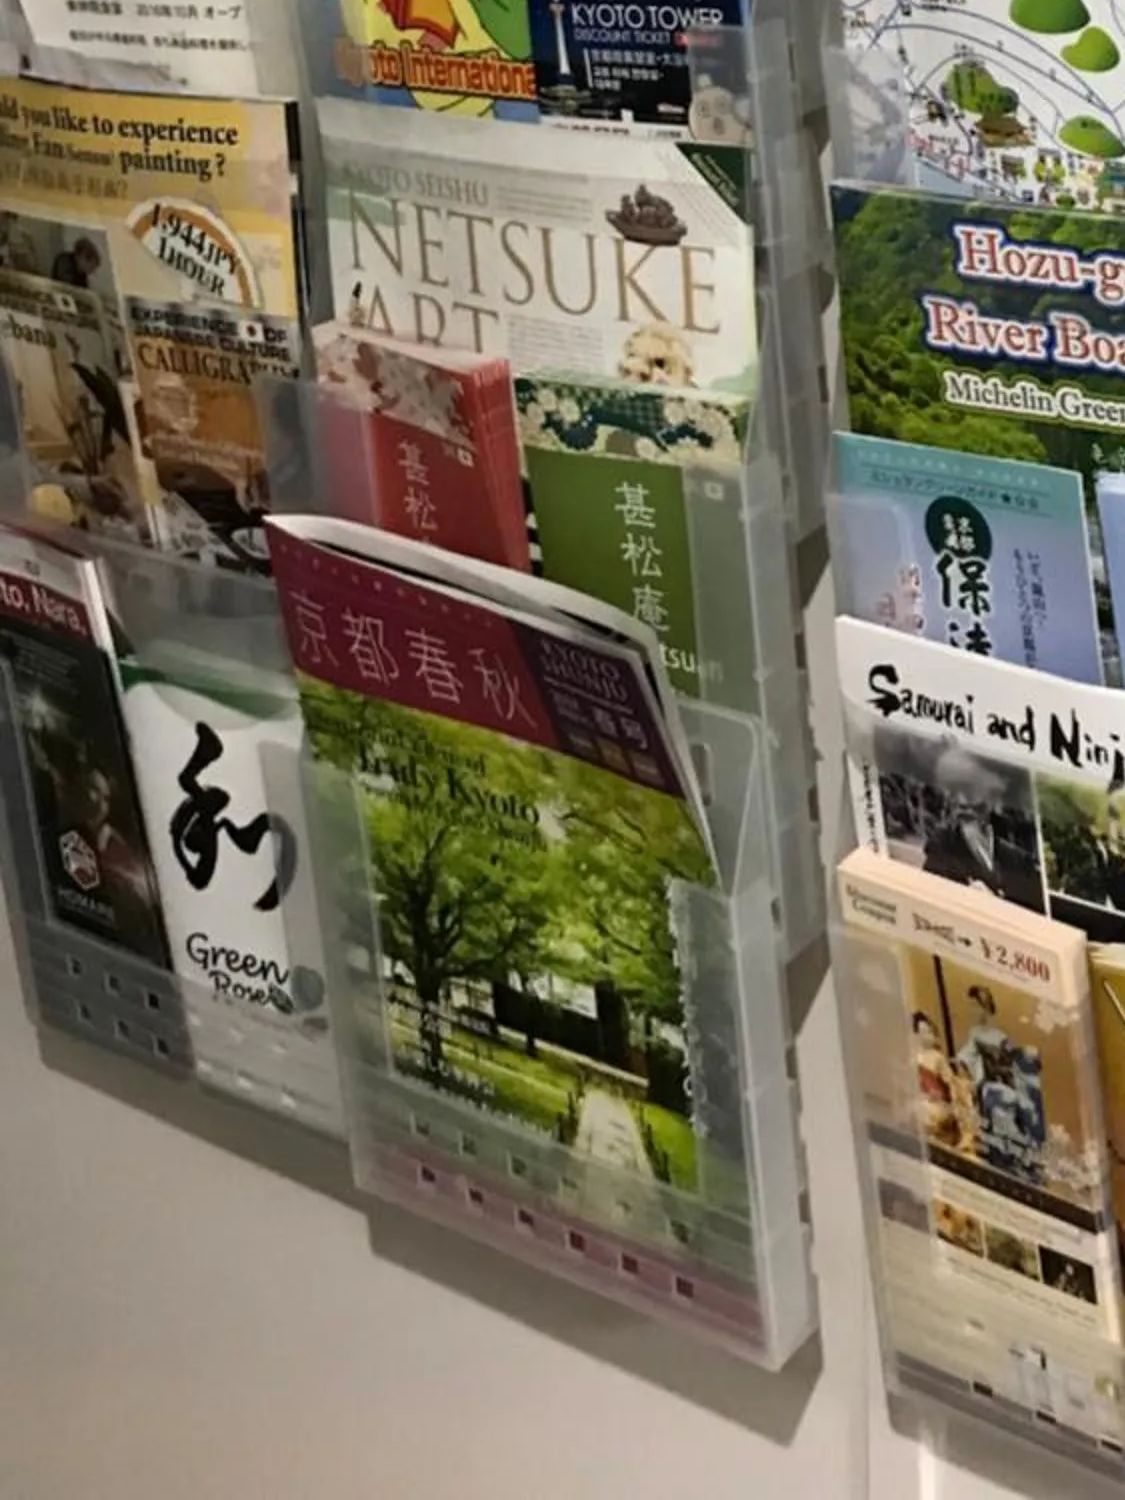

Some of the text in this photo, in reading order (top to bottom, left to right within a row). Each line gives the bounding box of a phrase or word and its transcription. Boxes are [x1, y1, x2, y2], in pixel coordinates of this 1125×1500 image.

[570, 2, 724, 31] KYOTO TOWER
[574, 28, 672, 44] DISCOUNT TICKET
[53, 106, 89, 134] like
[92, 115, 115, 136] to
[117, 117, 240, 146] experience
[119, 147, 214, 183] painting
[346, 190, 721, 337] NETSUKE
[924, 299, 1047, 359] River
[946, 372, 1056, 416] Michelin
[291, 588, 536, 729] 京都春秋
[866, 663, 977, 735] Samurai
[986, 705, 1036, 758] and
[185, 930, 291, 987] Green
[979, 936, 1052, 982] ¥2,800
